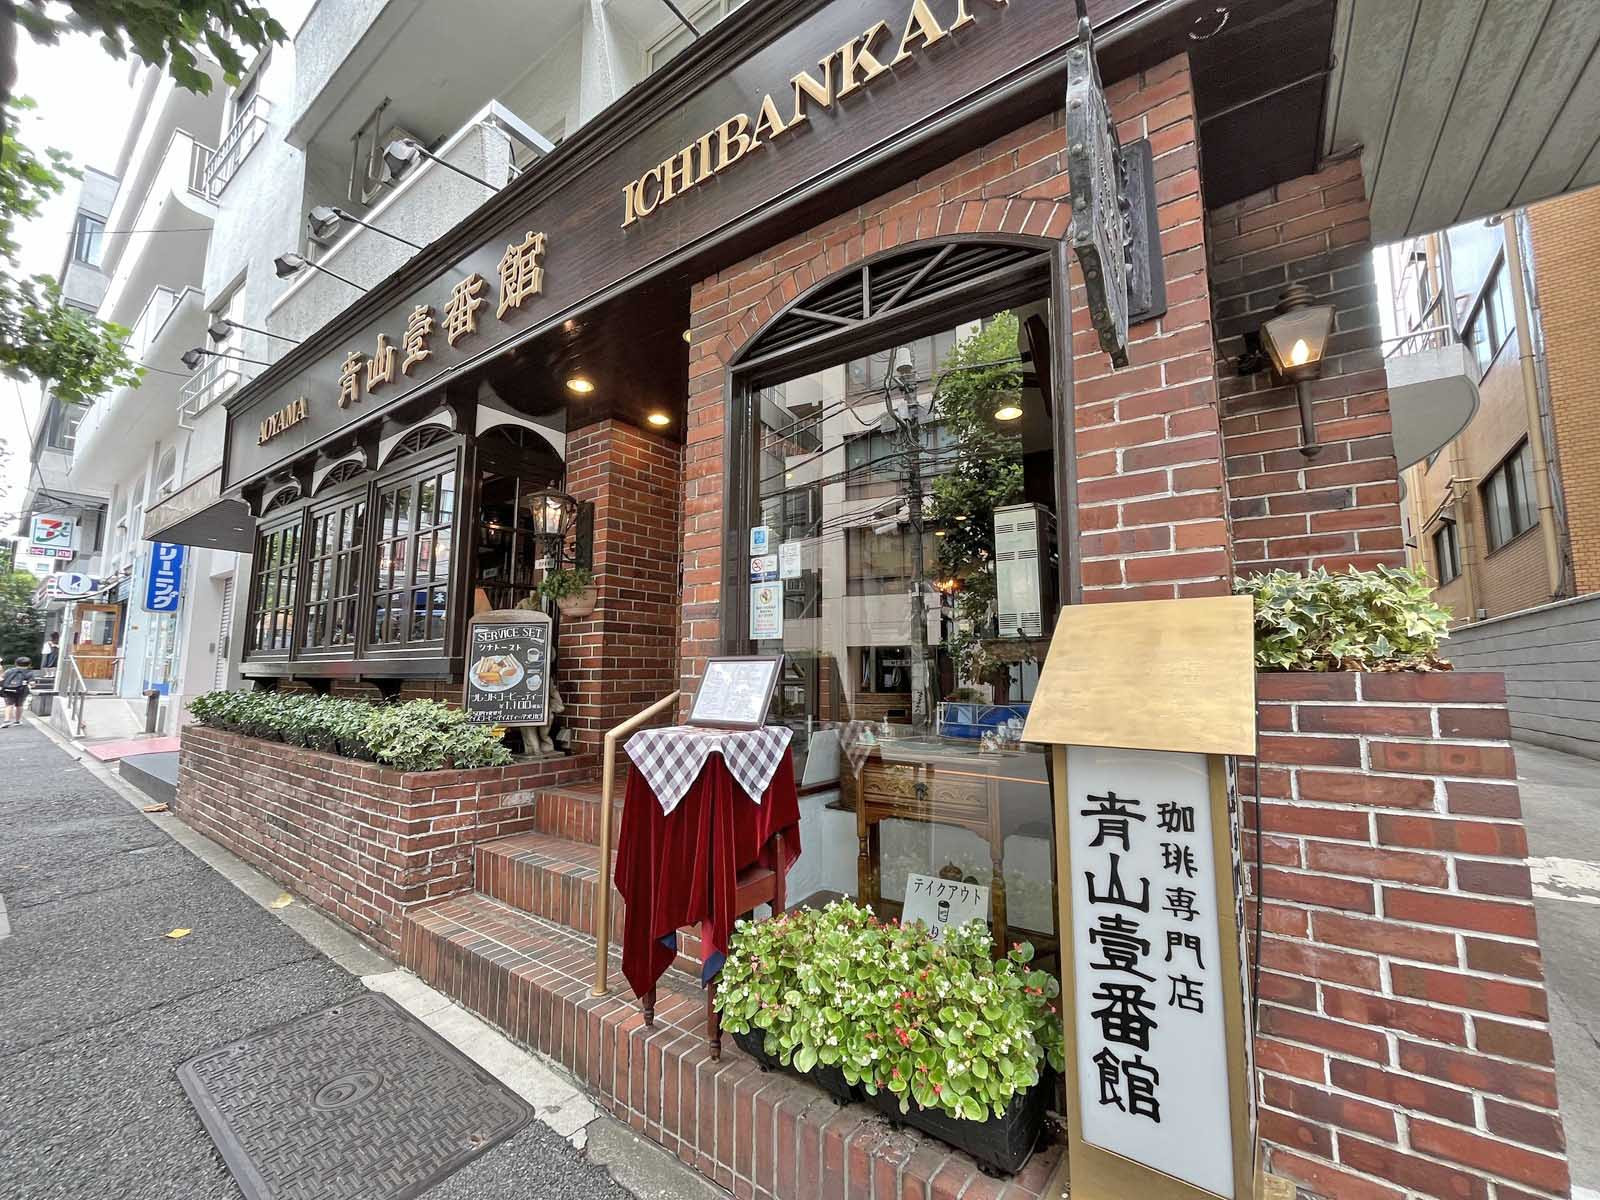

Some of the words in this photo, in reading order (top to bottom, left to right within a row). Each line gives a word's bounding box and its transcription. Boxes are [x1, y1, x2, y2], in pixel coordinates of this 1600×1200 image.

[620, 0, 1008, 230] ICHIBANKA
[257, 396, 310, 447] AOYAMA
[154, 543, 178, 608] リーニング
[478, 628, 520, 642] SERVICE
[522, 627, 543, 638] SET
[479, 643, 522, 652] ツナトースト
[914, 878, 981, 905] テイクアウト
[1157, 800, 1206, 1014] 珈琲専門店
[1080, 791, 1161, 1124] 青山壹番館
